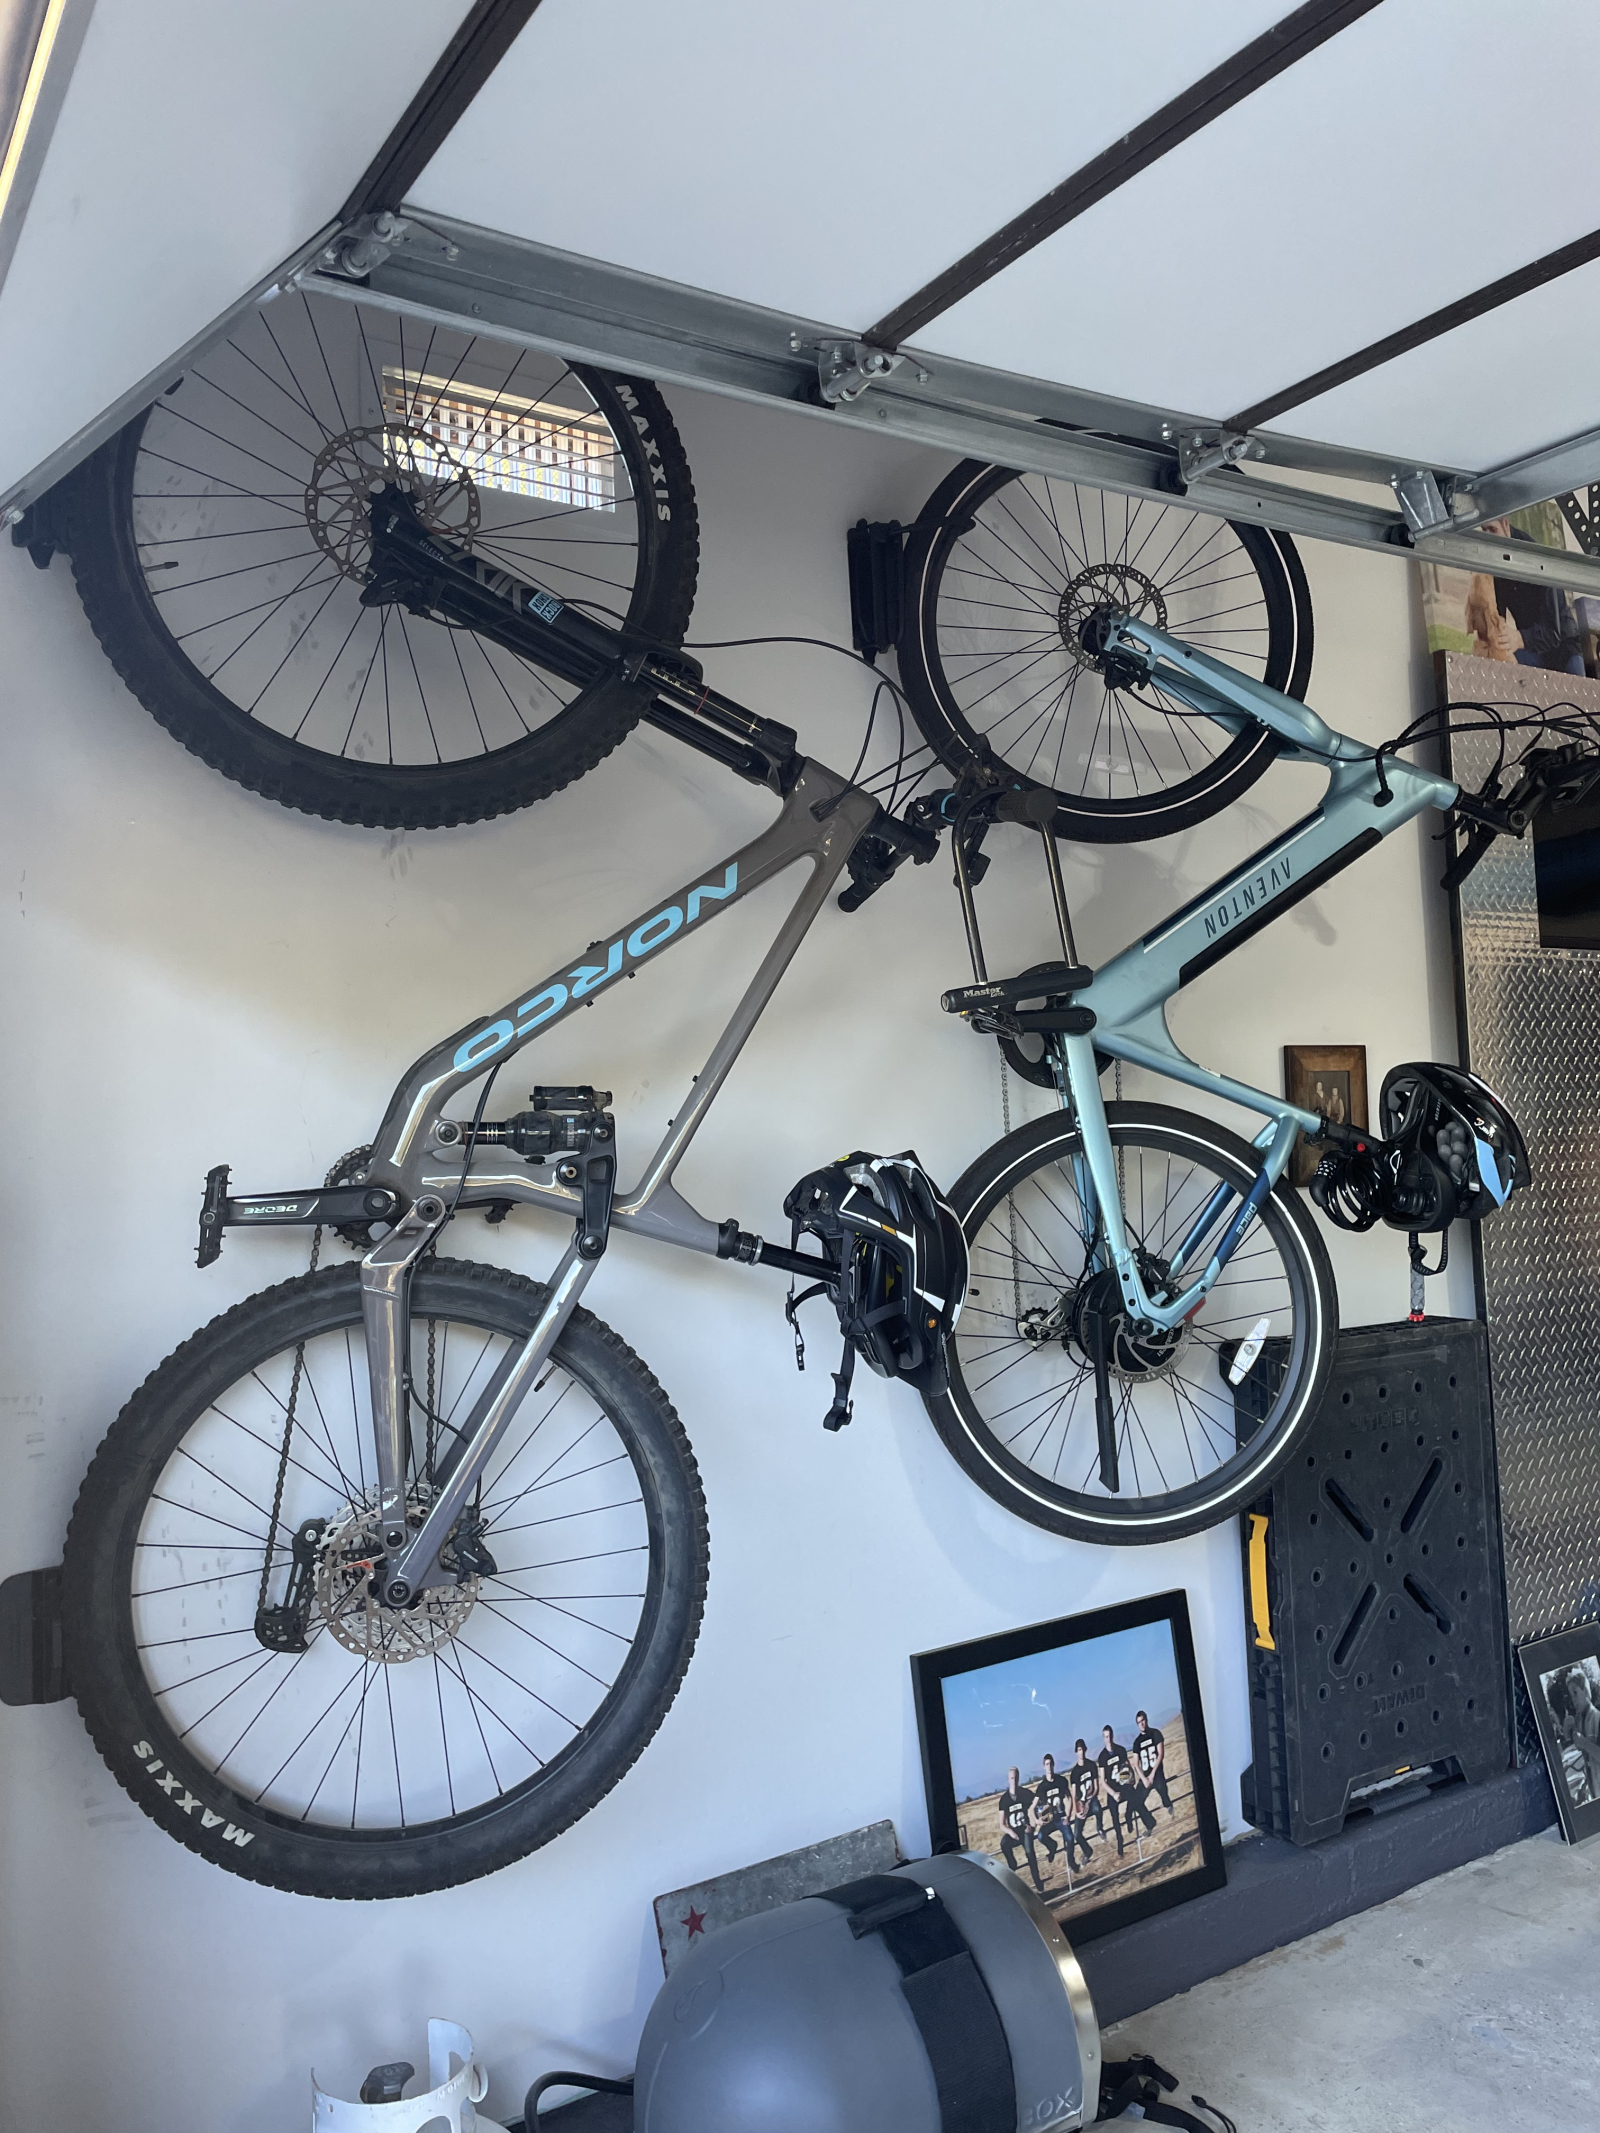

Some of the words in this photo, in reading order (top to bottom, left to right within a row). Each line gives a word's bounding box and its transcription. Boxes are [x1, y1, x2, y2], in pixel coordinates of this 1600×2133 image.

[615, 385, 671, 521] MAXXIS
[531, 591, 550, 611] SHOX
[541, 598, 564, 623] ROCK
[1204, 857, 1292, 939] AVENTON
[453, 861, 739, 1072] NORCO
[963, 987, 1001, 998] Master
[243, 1204, 298, 1215] DEORE
[1235, 1201, 1258, 1236] pace
[133, 1740, 255, 1848] MAXXIS
